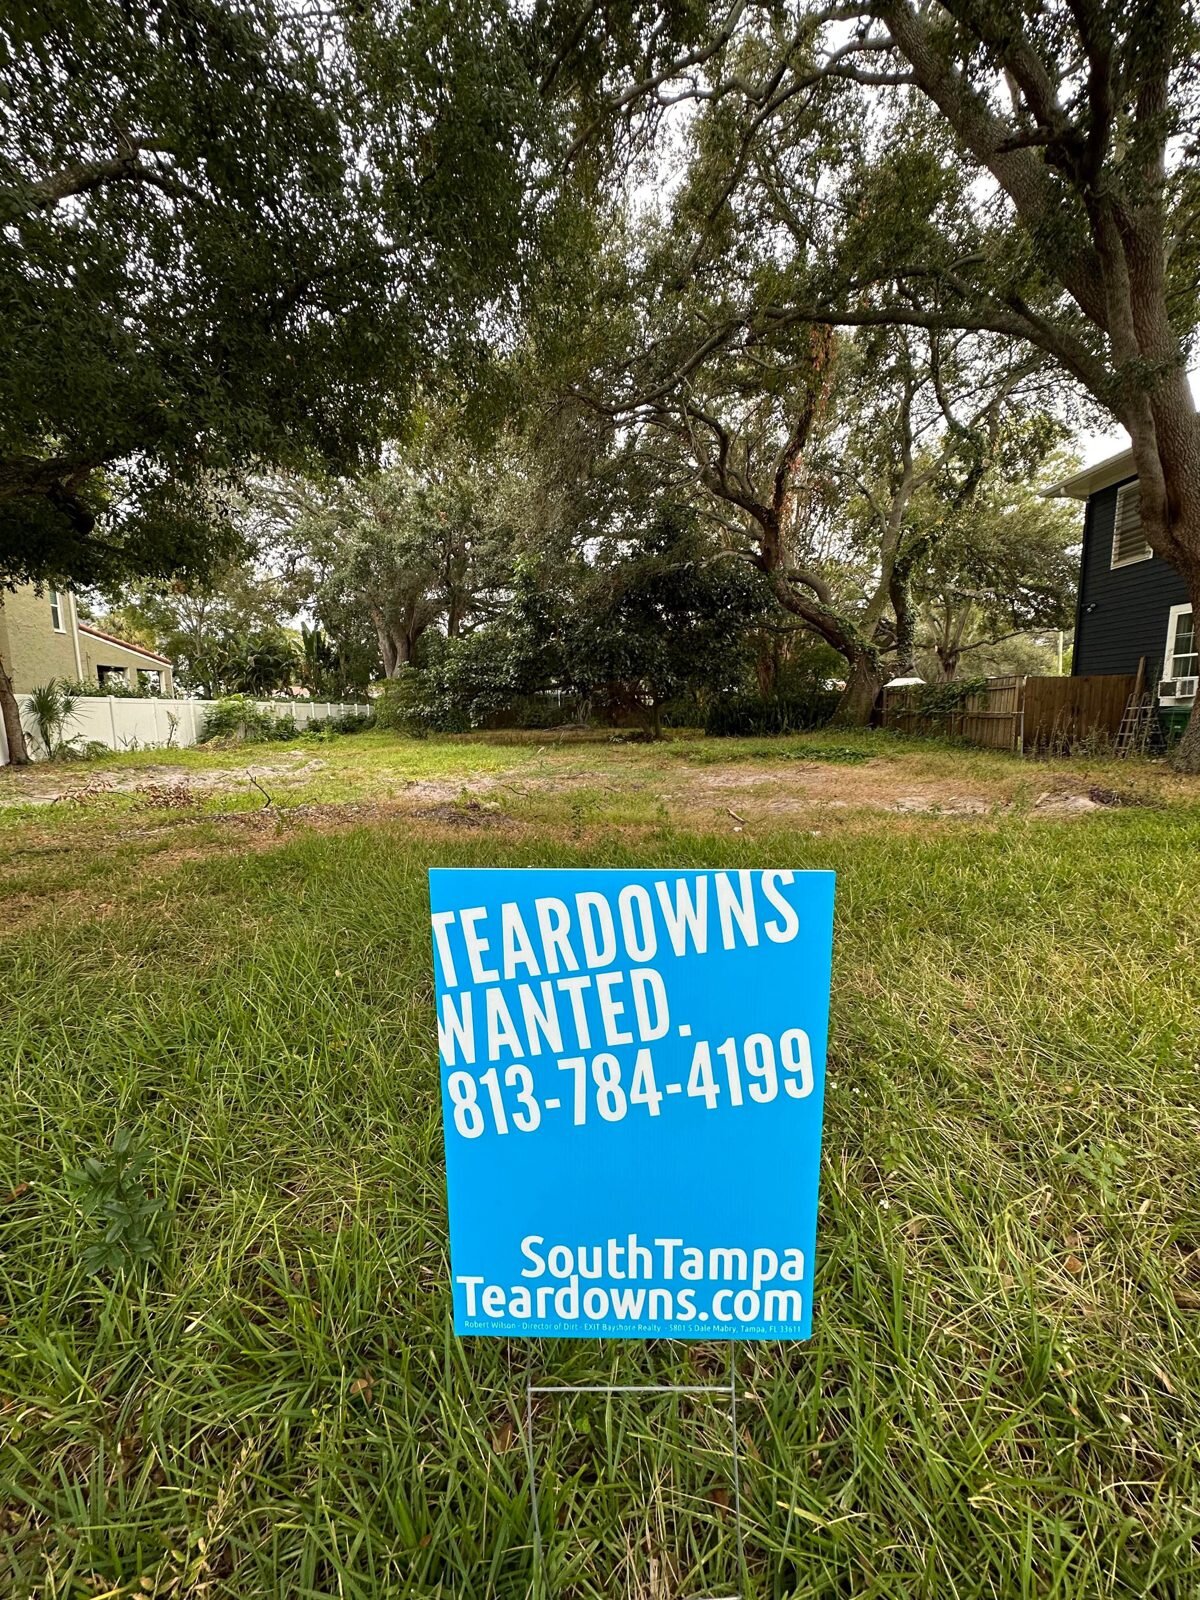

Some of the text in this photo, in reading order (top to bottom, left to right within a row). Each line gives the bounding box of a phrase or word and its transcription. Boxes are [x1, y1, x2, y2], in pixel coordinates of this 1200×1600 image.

[431, 870, 800, 988] TEARDOWNS
[437, 968, 691, 1066] WANTED.
[448, 1029, 814, 1138] 813-784-4199
[457, 1275, 802, 1321] Teardowns.com
[521, 1234, 804, 1290] SouthTampa
[464, 1320, 489, 1329] Robert
[491, 1321, 516, 1329] Wilson
[522, 1322, 552, 1330] Director
[553, 1322, 561, 1330] of
[563, 1323, 578, 1331] Dirt
[584, 1323, 600, 1331] EXIT
[602, 1323, 636, 1332] Bayshore
[637, 1324, 661, 1333] Realty
[669, 1324, 686, 1332] 5801
[688, 1324, 693, 1332] S
[694, 1324, 711, 1332] Dale
[712, 1324, 739, 1333] Mabry,
[740, 1325, 767, 1334] Tampa,
[769, 1325, 778, 1333] FL
[780, 1325, 801, 1333] 33611
